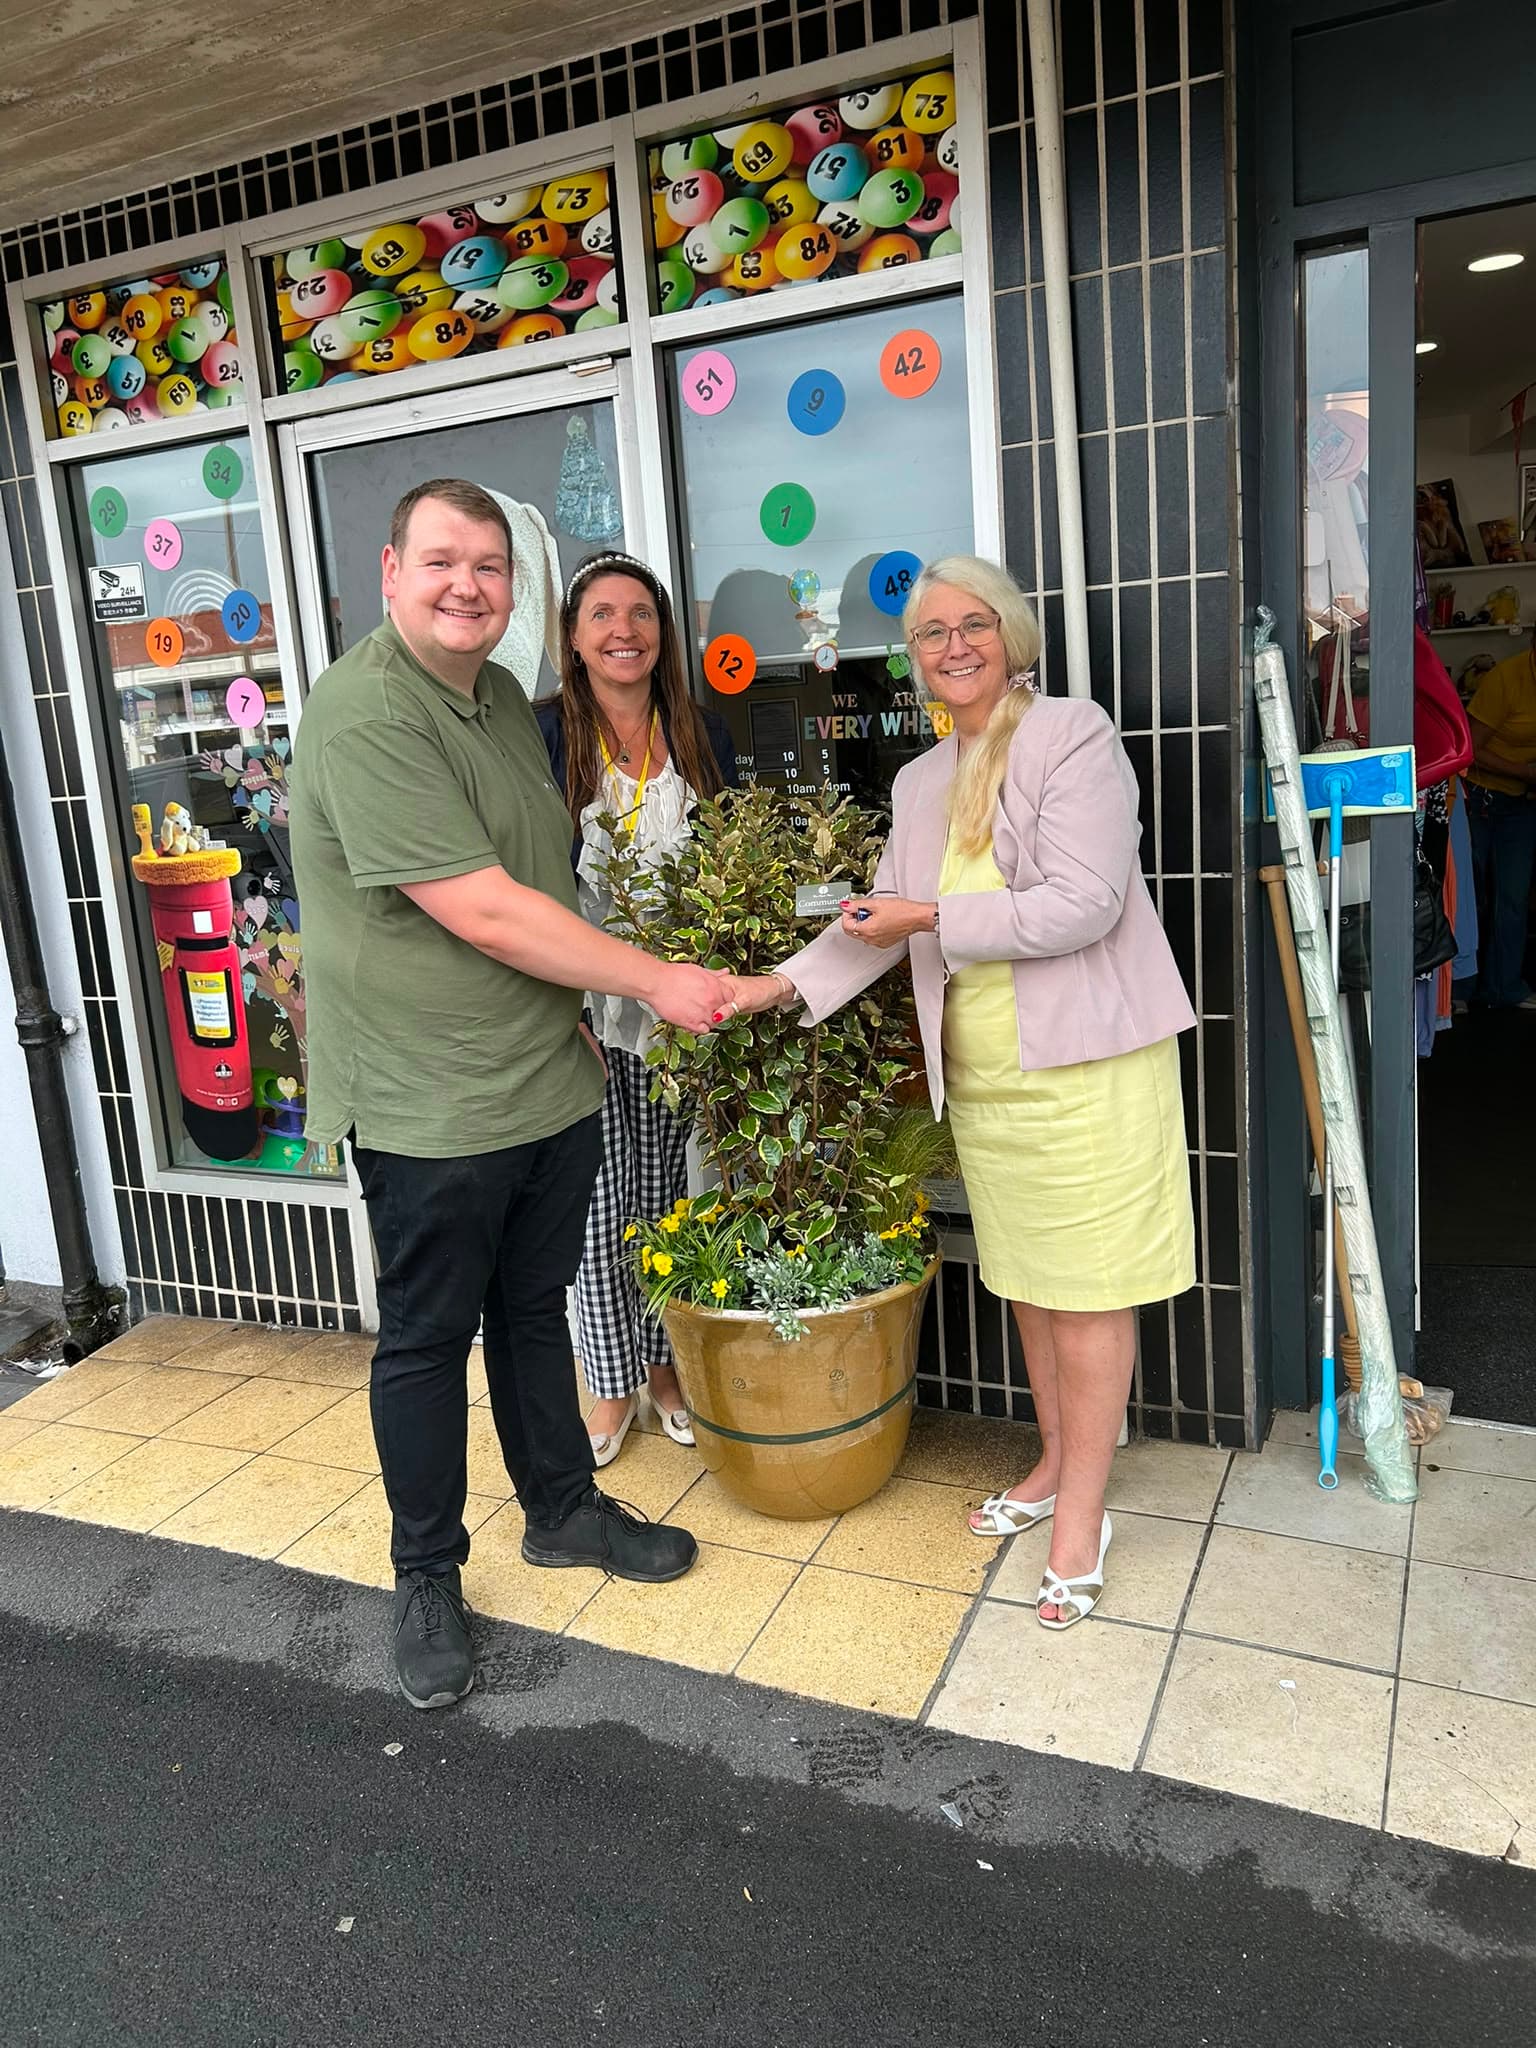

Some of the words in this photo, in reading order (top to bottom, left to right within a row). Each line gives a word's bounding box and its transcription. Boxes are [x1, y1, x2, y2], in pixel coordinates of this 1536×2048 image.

[915, 94, 947, 119] 73
[876, 134, 908, 162] 81
[555, 187, 592, 210] 73
[889, 179, 911, 204] 3
[516, 224, 550, 250] 81
[829, 211, 861, 240] 42
[799, 233, 831, 261] 84
[531, 266, 553, 288] 3
[125, 310, 146, 332] 84
[465, 298, 501, 323] 42
[106, 325, 129, 349] 42
[434, 319, 468, 345] 84
[79, 351, 93, 370] 3
[218, 359, 240, 382] 29
[894, 347, 926, 377] 42
[85, 383, 104, 402] 81
[121, 371, 142, 393] 51
[695, 367, 724, 402] 51
[804, 387, 826, 415] 9
[66, 410, 86, 430] 73
[210, 460, 232, 485] 34
[99, 499, 118, 527] 29
[152, 534, 174, 557] 37
[120, 586, 136, 597] 24H
[884, 569, 913, 598] 48
[230, 604, 252, 631] 20
[153, 633, 173, 653] 19
[717, 649, 744, 680] 12
[239, 694, 250, 713] 7
[832, 694, 858, 708] WE
[804, 715, 872, 740] EVERY
[880, 711, 953, 737] WHER
[783, 751, 795, 762] 10
[822, 749, 829, 759] 5
[785, 768, 797, 779] 10
[823, 764, 830, 774] 5
[786, 784, 816, 794] 10am
[789, 816, 808, 826] 10a
[798, 894, 850, 908] Communi
